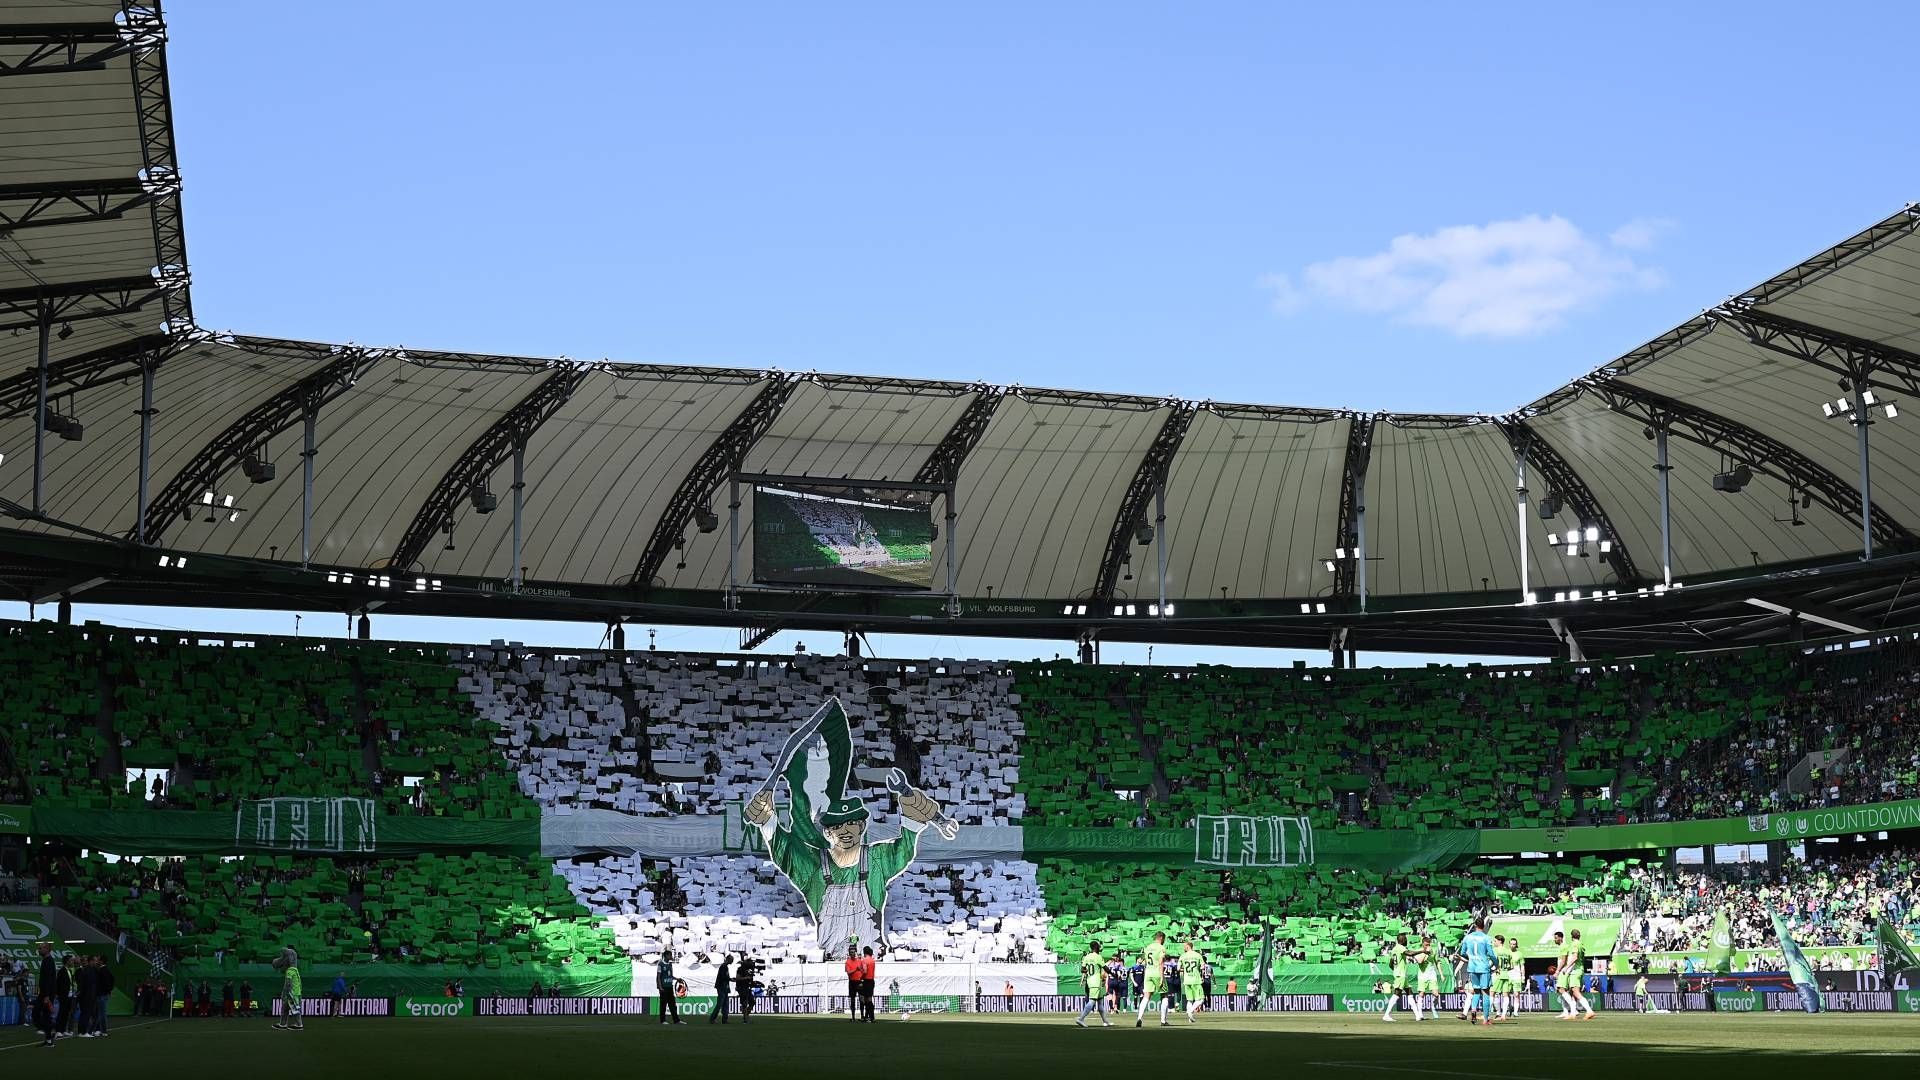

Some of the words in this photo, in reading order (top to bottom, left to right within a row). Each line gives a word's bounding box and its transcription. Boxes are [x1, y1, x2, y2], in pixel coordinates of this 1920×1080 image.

[1814, 805, 1920, 832] COUNTDOWN
[1147, 952, 1153, 965] 5
[272, 998, 332, 1016] INTMENT
[335, 998, 389, 1015] LATTFORM
[480, 998, 495, 1015] DIE
[496, 998, 589, 1015] SOCIAL-INVESTMENT
[591, 998, 643, 1014] PLATTFORM
[980, 995, 1063, 1012] SOCIAL-INVESTMENT
[1284, 994, 1328, 1011] PLATTFORM
[1767, 992, 1778, 1009] DIE
[1850, 992, 1892, 1010] PLATTFORM
